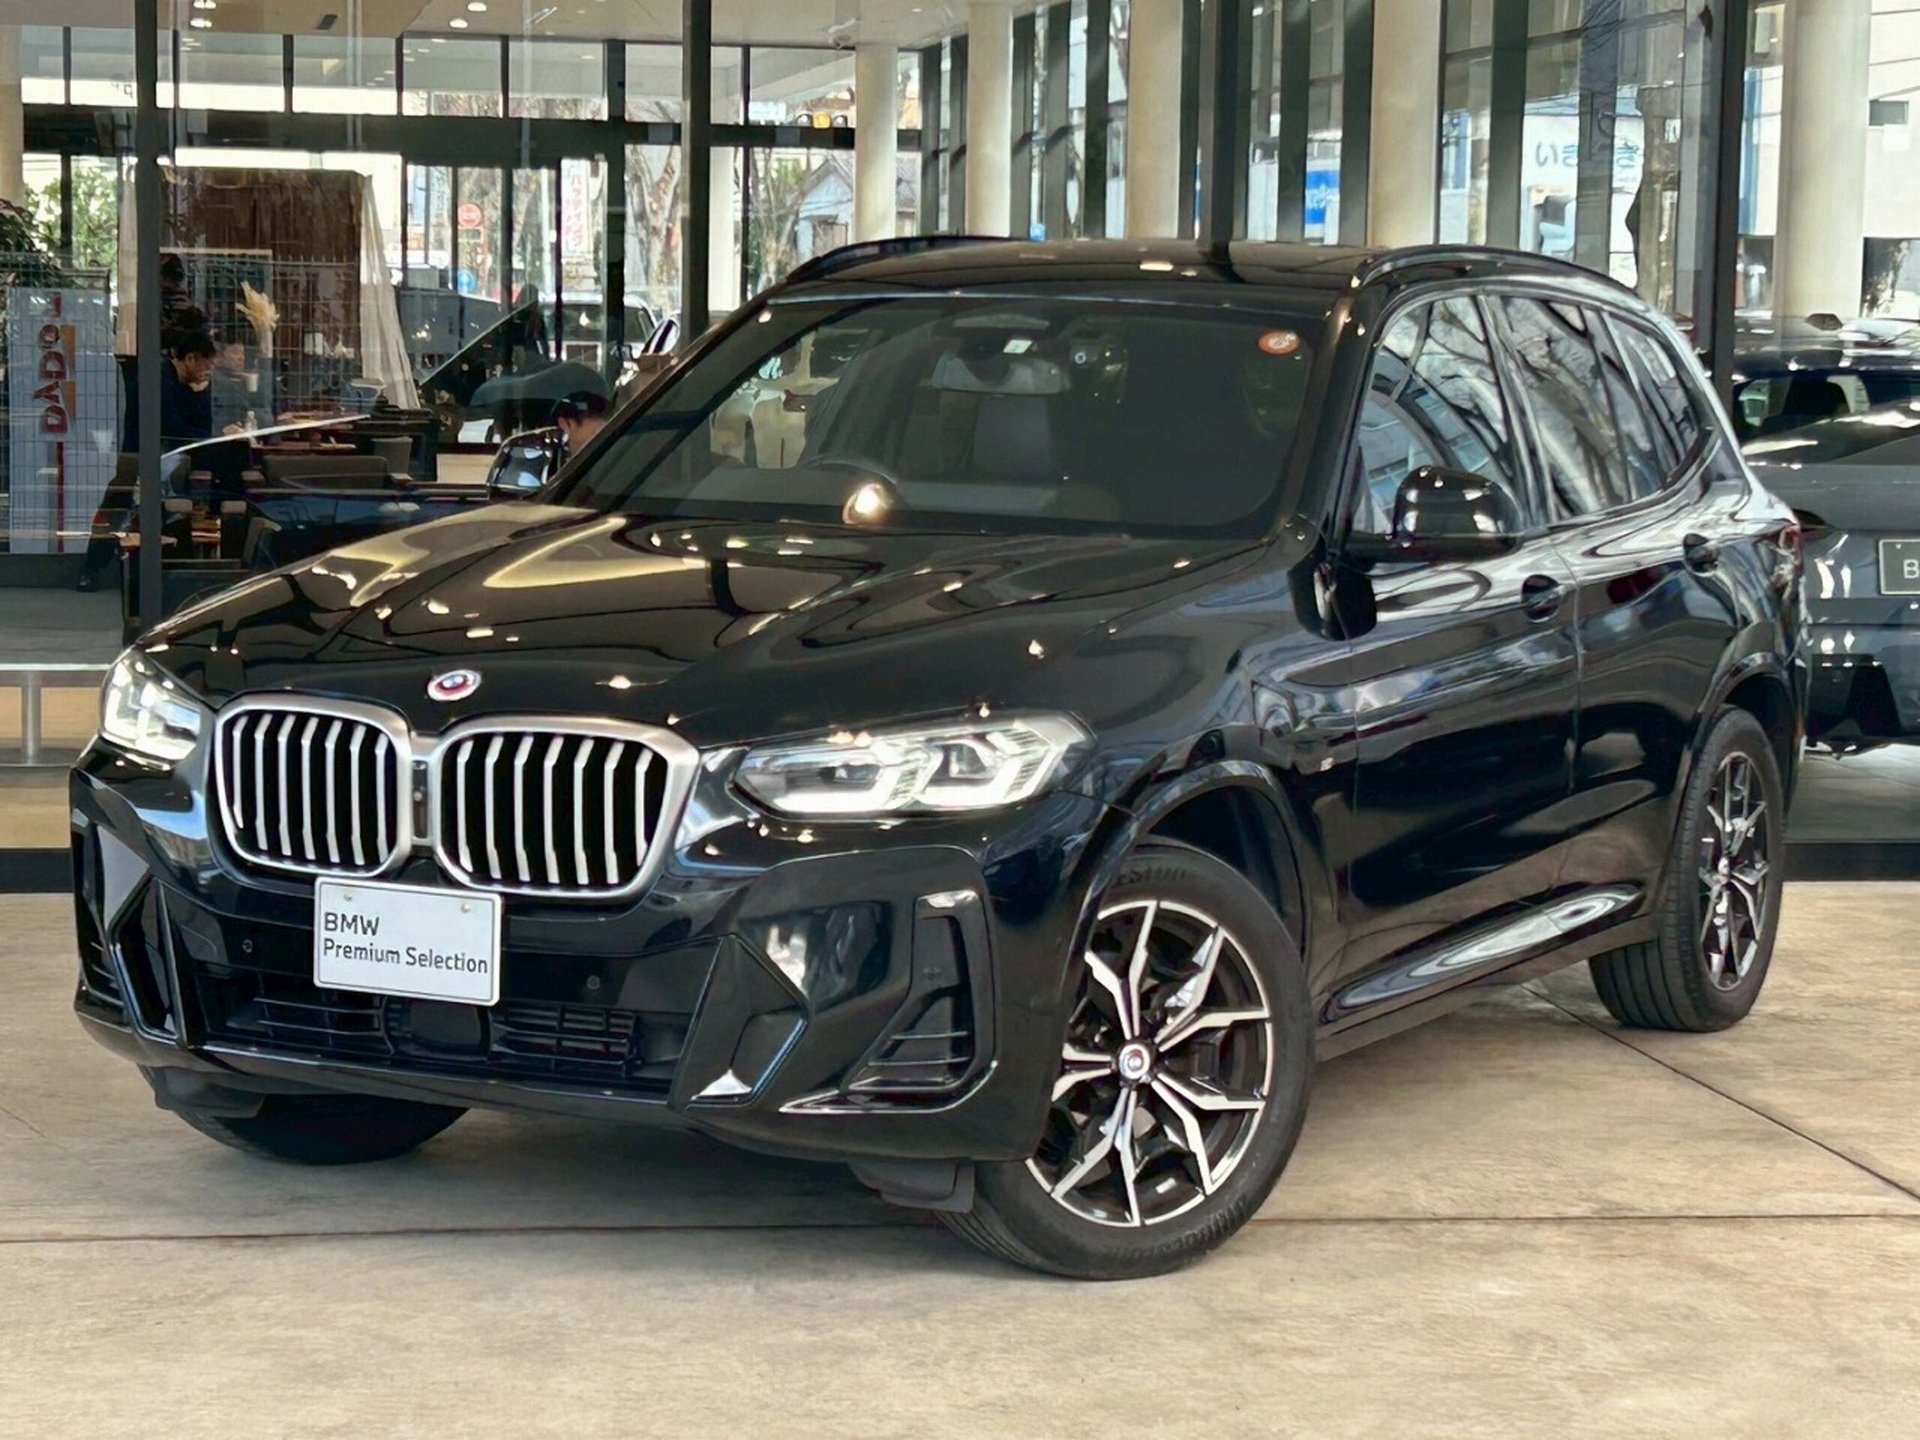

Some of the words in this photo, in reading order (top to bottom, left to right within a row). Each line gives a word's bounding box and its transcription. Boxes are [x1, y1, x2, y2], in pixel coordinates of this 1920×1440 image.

[324, 912, 380, 936] BMW
[323, 938, 400, 964] Premium
[405, 947, 488, 974] Selection
